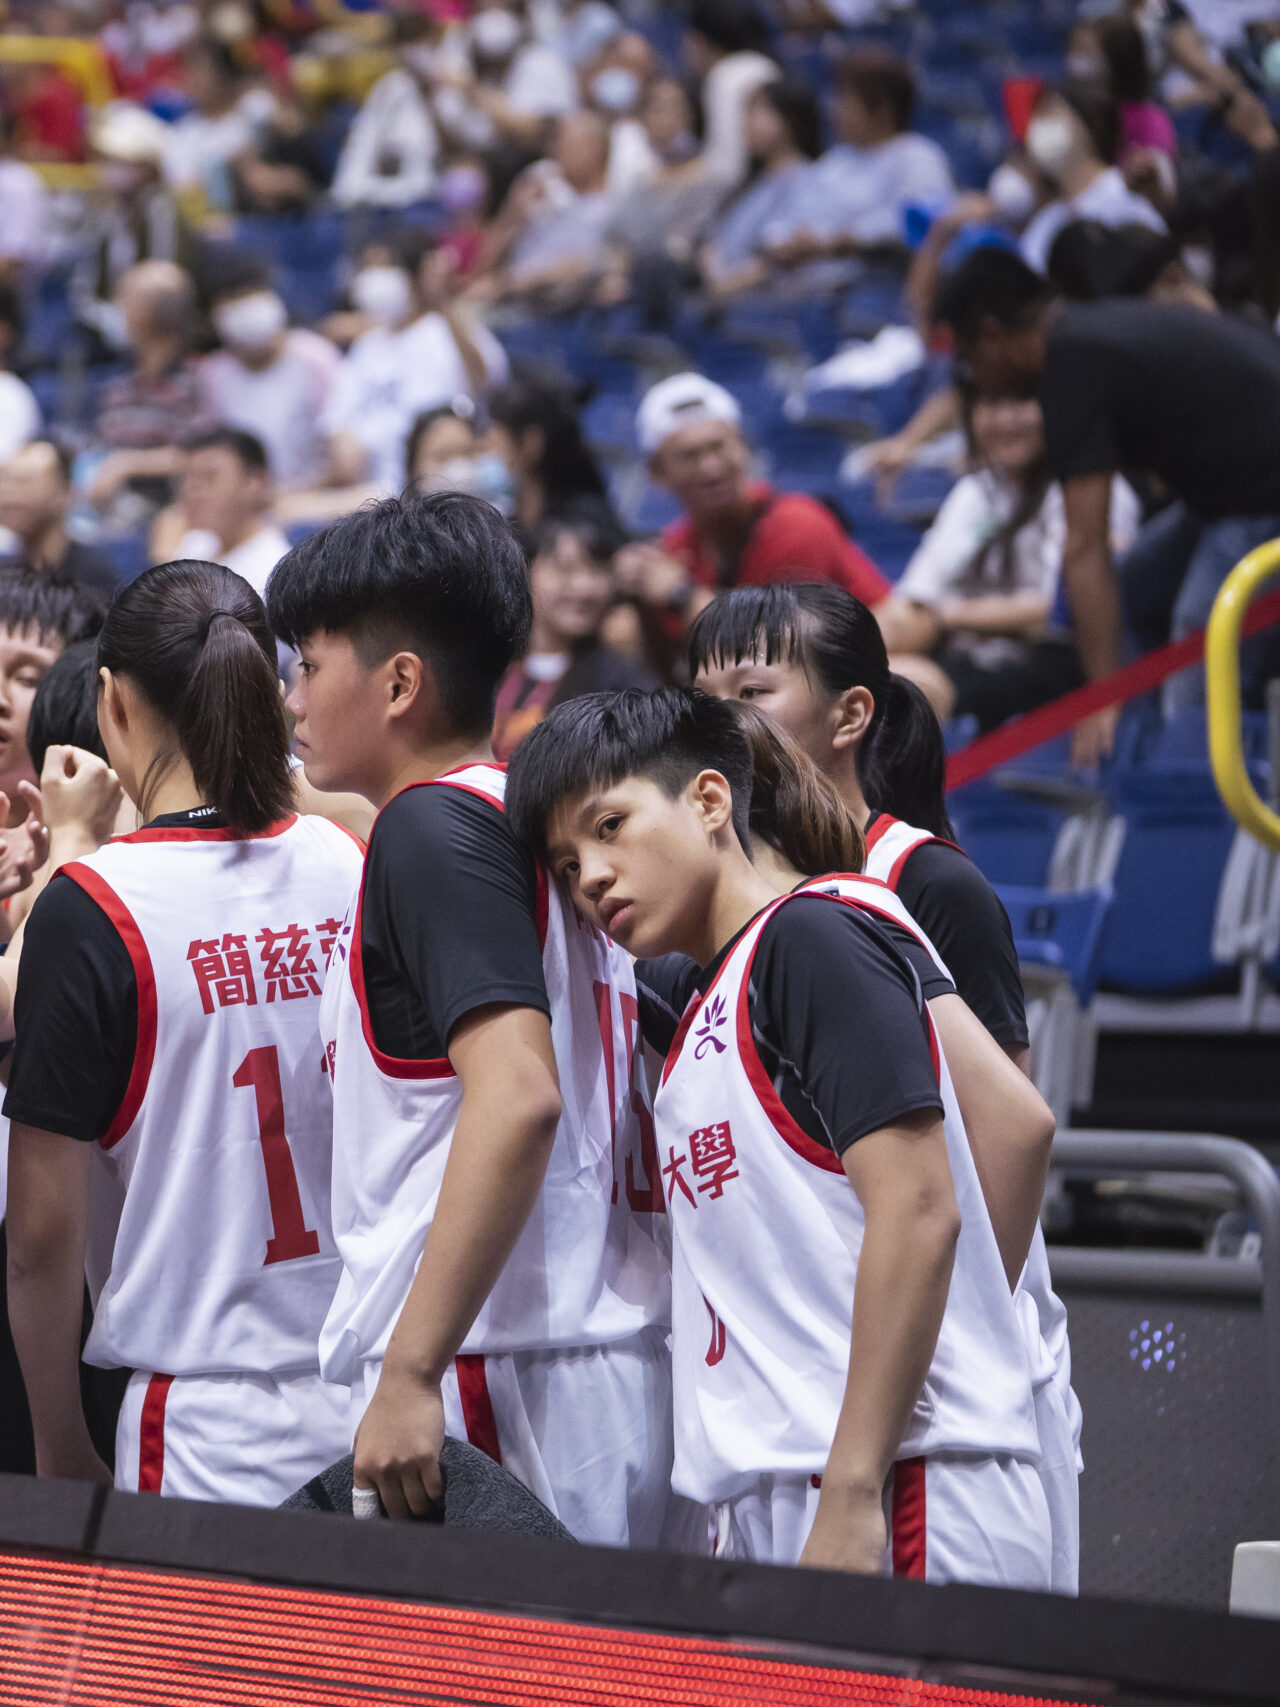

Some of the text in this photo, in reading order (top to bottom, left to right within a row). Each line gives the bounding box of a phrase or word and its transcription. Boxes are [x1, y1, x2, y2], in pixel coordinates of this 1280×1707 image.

[188, 806, 223, 819] NIK
[232, 1044, 329, 1266] 1
[662, 1119, 740, 1210] 大學
